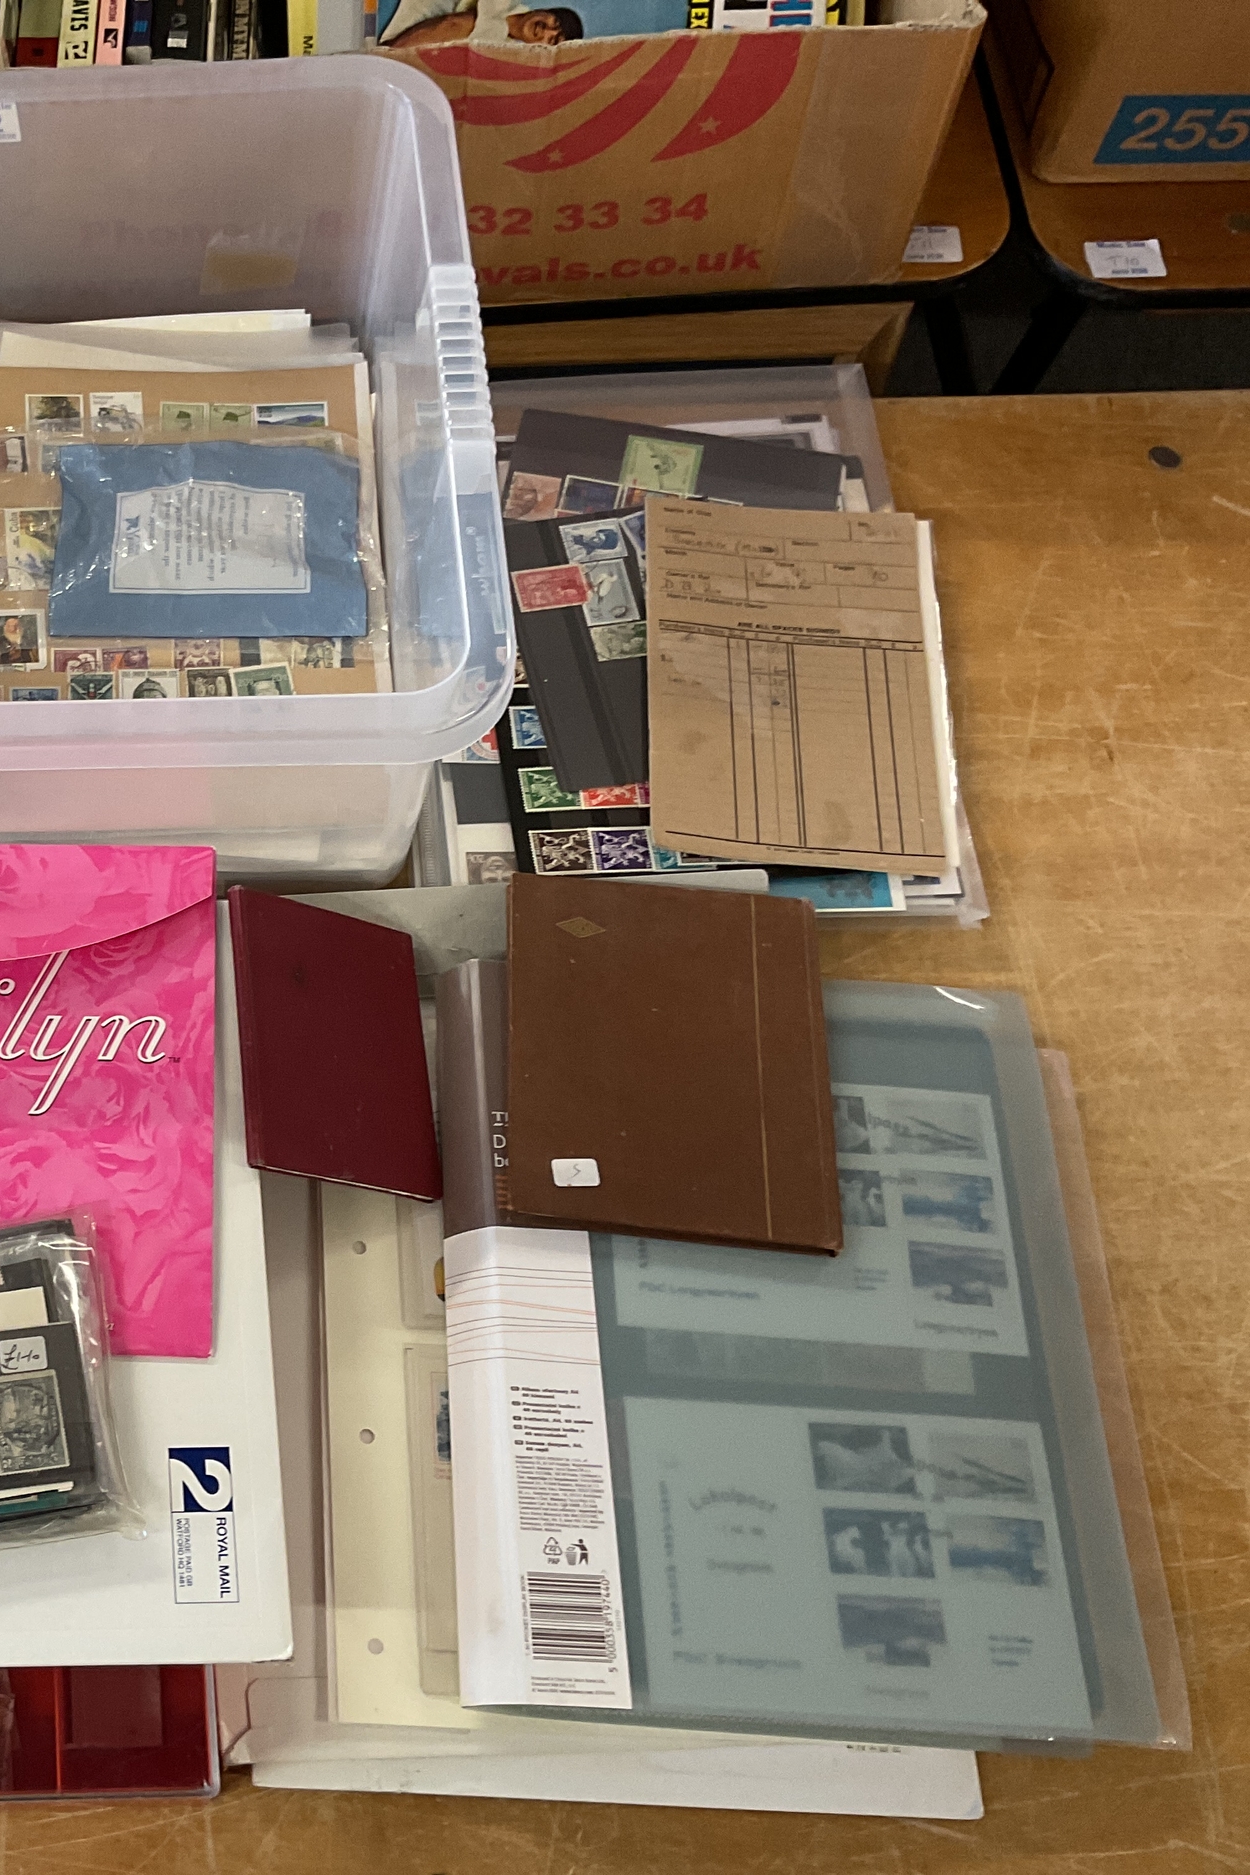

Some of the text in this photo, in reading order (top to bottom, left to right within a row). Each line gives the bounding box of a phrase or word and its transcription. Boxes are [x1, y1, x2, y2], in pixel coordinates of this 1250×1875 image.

[553, 201, 620, 233] 33
[642, 193, 708, 226] 34
[476, 244, 762, 286] vals.co.uk
[9, 512, 19, 532] Cuba
[169, 1458, 232, 1512] 2
[175, 1518, 185, 1556] WATFORD
[183, 1517, 192, 1553] POSTAGE
[177, 1557, 185, 1570] HQ
[215, 1517, 232, 1599] ROYAL MAIL
